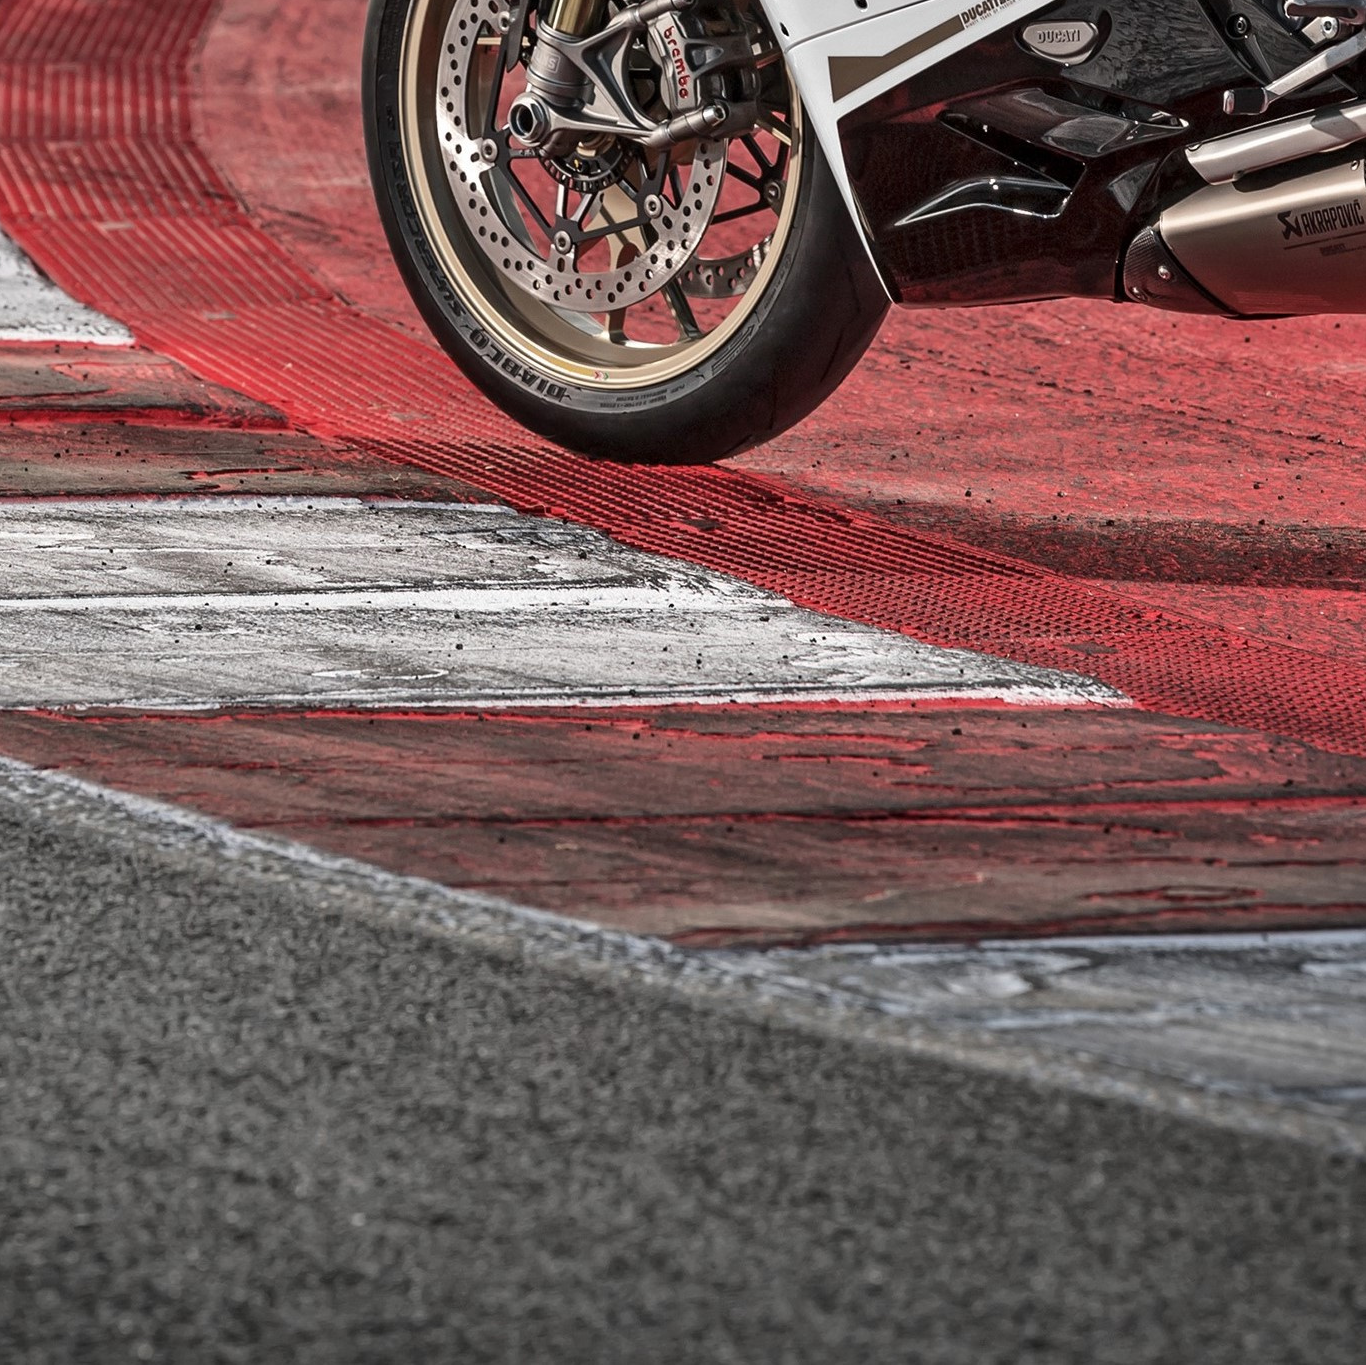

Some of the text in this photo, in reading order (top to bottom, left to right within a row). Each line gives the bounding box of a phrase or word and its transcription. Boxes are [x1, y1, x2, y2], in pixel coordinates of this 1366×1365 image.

[663, 25, 691, 99] brembo
[1037, 29, 1081, 44] DUCATI
[469, 328, 567, 403] DIABLO
